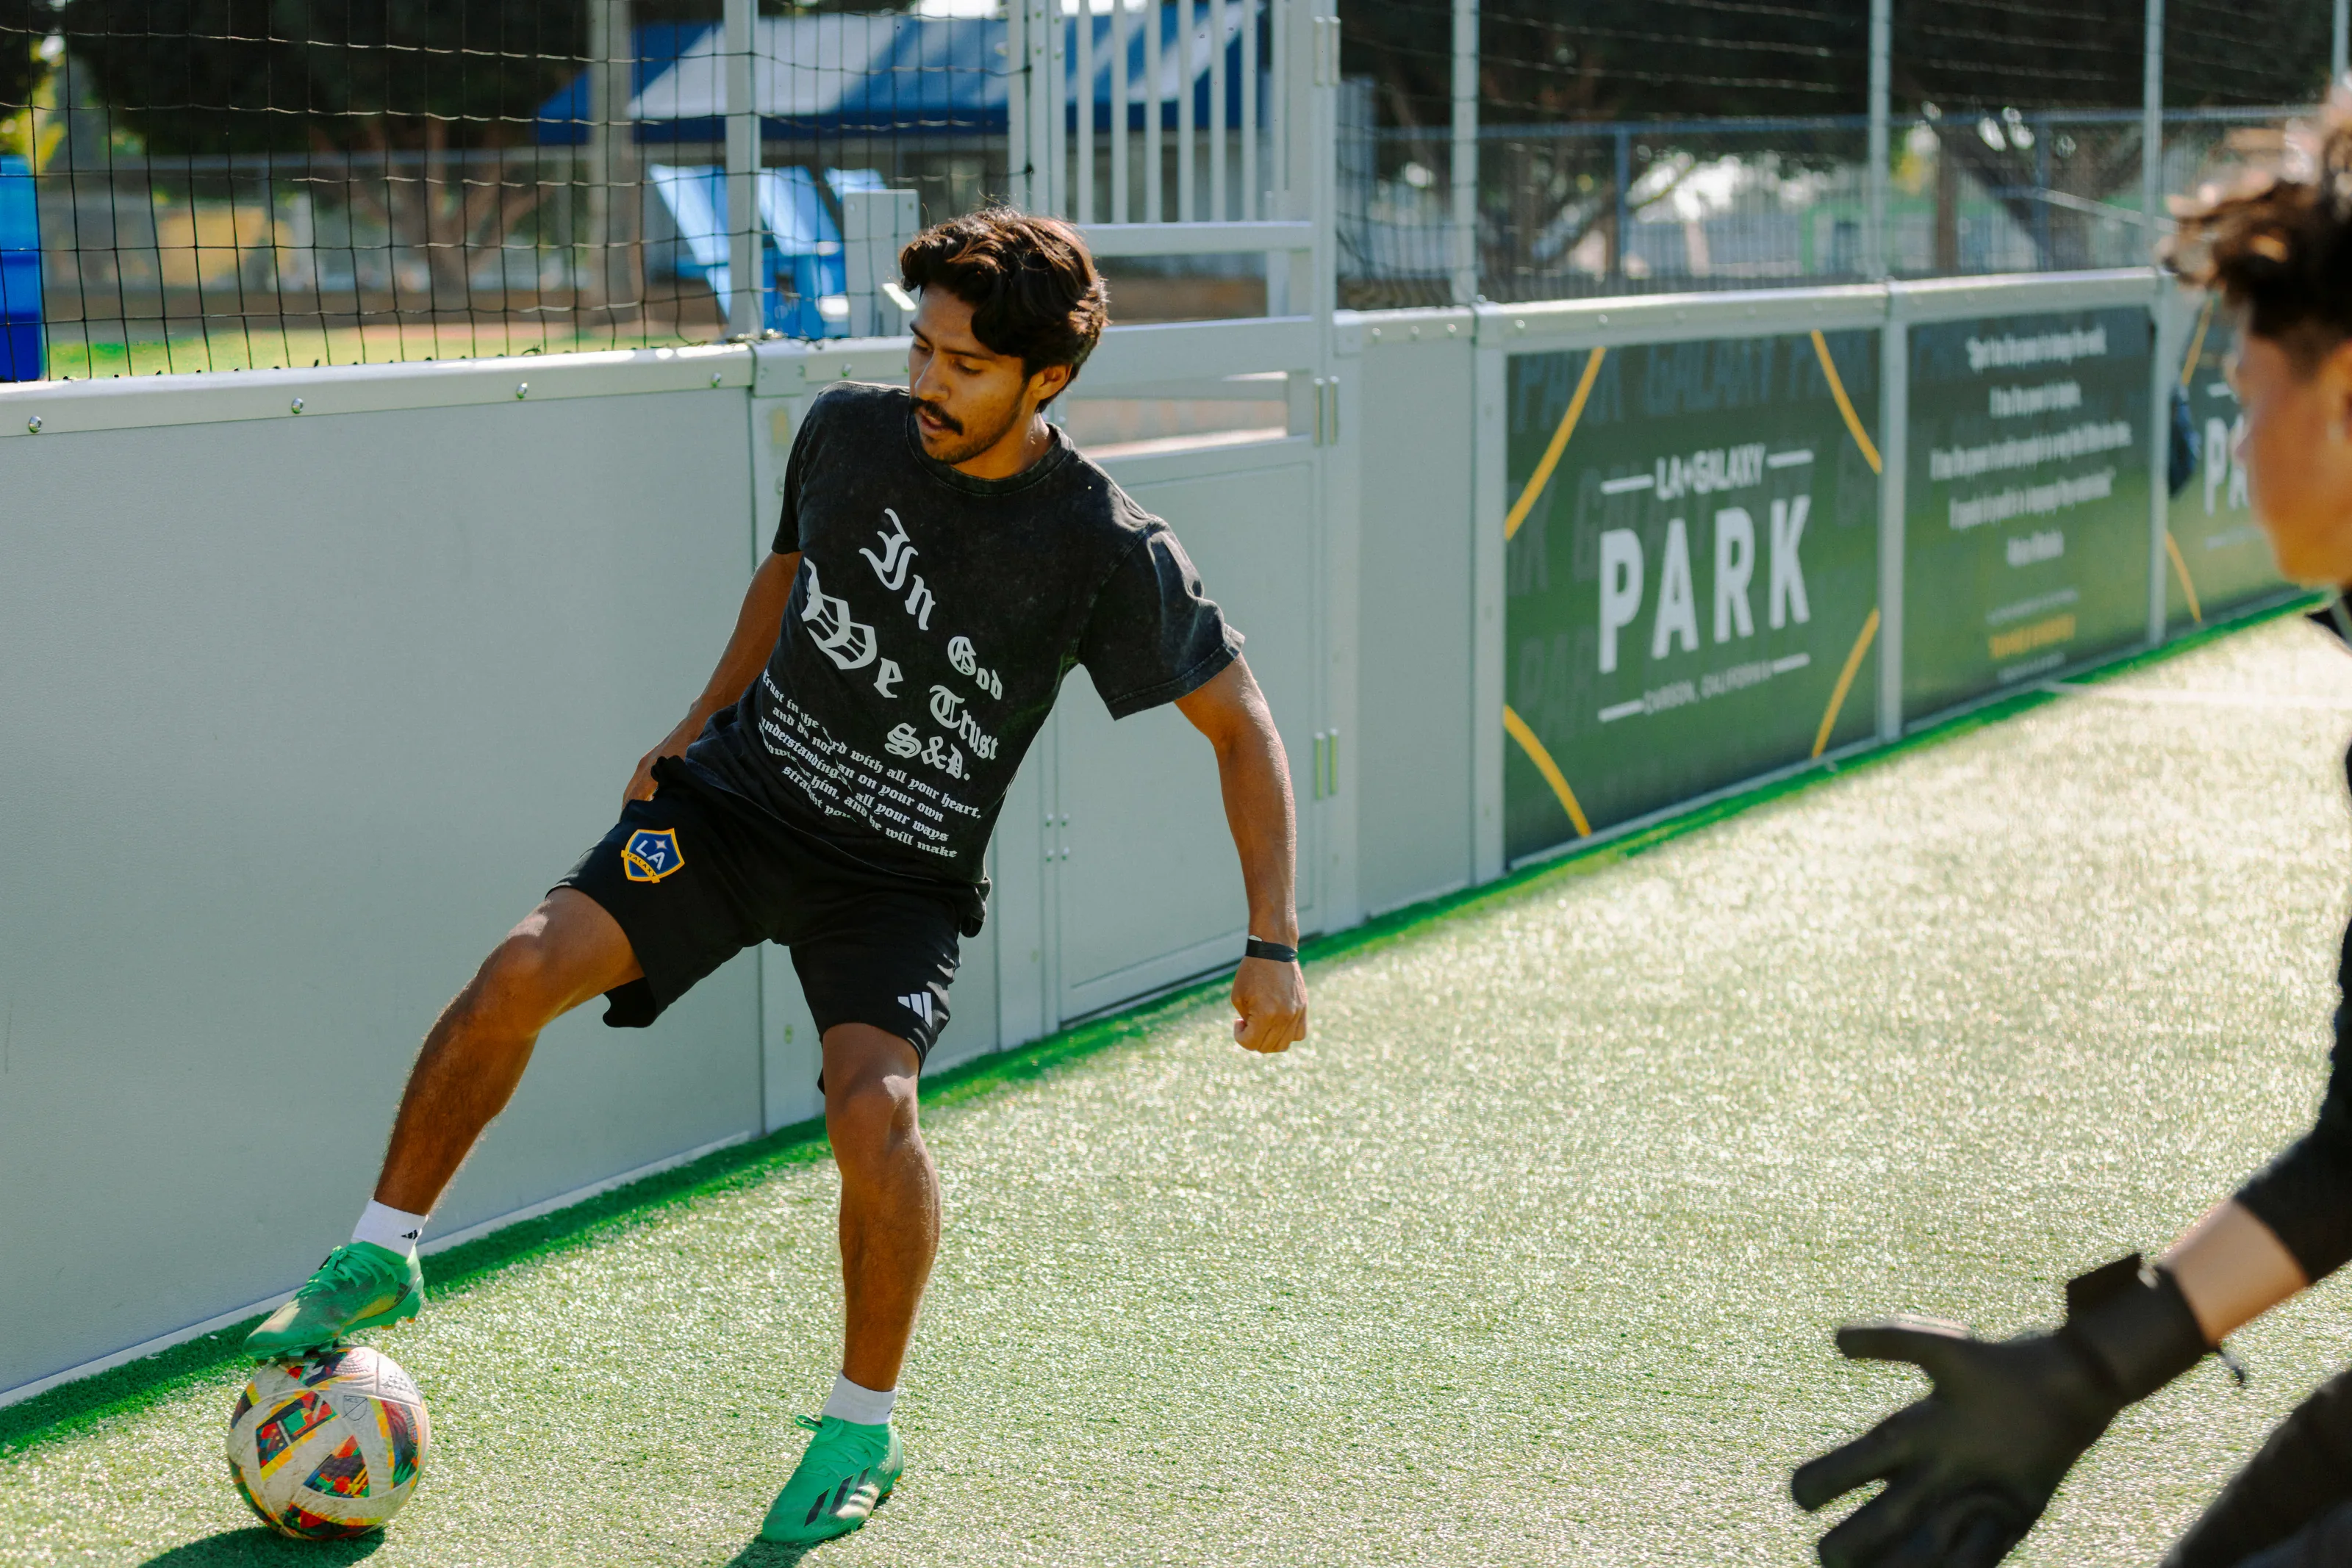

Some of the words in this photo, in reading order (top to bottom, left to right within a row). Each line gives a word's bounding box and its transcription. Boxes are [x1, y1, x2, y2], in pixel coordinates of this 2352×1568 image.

[1656, 455, 1685, 500] LA
[859, 508, 936, 630] In
[947, 636, 1003, 700] God
[1599, 493, 1812, 675] PARK
[786, 699, 799, 713] in
[800, 711, 820, 728] the
[850, 749, 883, 774] with
[886, 768, 908, 784] all
[908, 778, 940, 799] your
[941, 792, 982, 819] heart,
[884, 722, 971, 781] S&D.
[929, 684, 999, 760] Trust
[772, 707, 795, 727] and
[811, 736, 835, 755] not
[857, 774, 878, 790] on
[878, 785, 915, 807] your
[917, 802, 944, 823] own
[810, 775, 840, 800] him,
[844, 796, 868, 818] and
[885, 827, 914, 846] will
[917, 841, 958, 858] make
[855, 792, 875, 808] all
[873, 803, 911, 824] your
[912, 820, 950, 841] ways
[627, 853, 656, 877] GALAXY
[635, 839, 666, 871] LA
